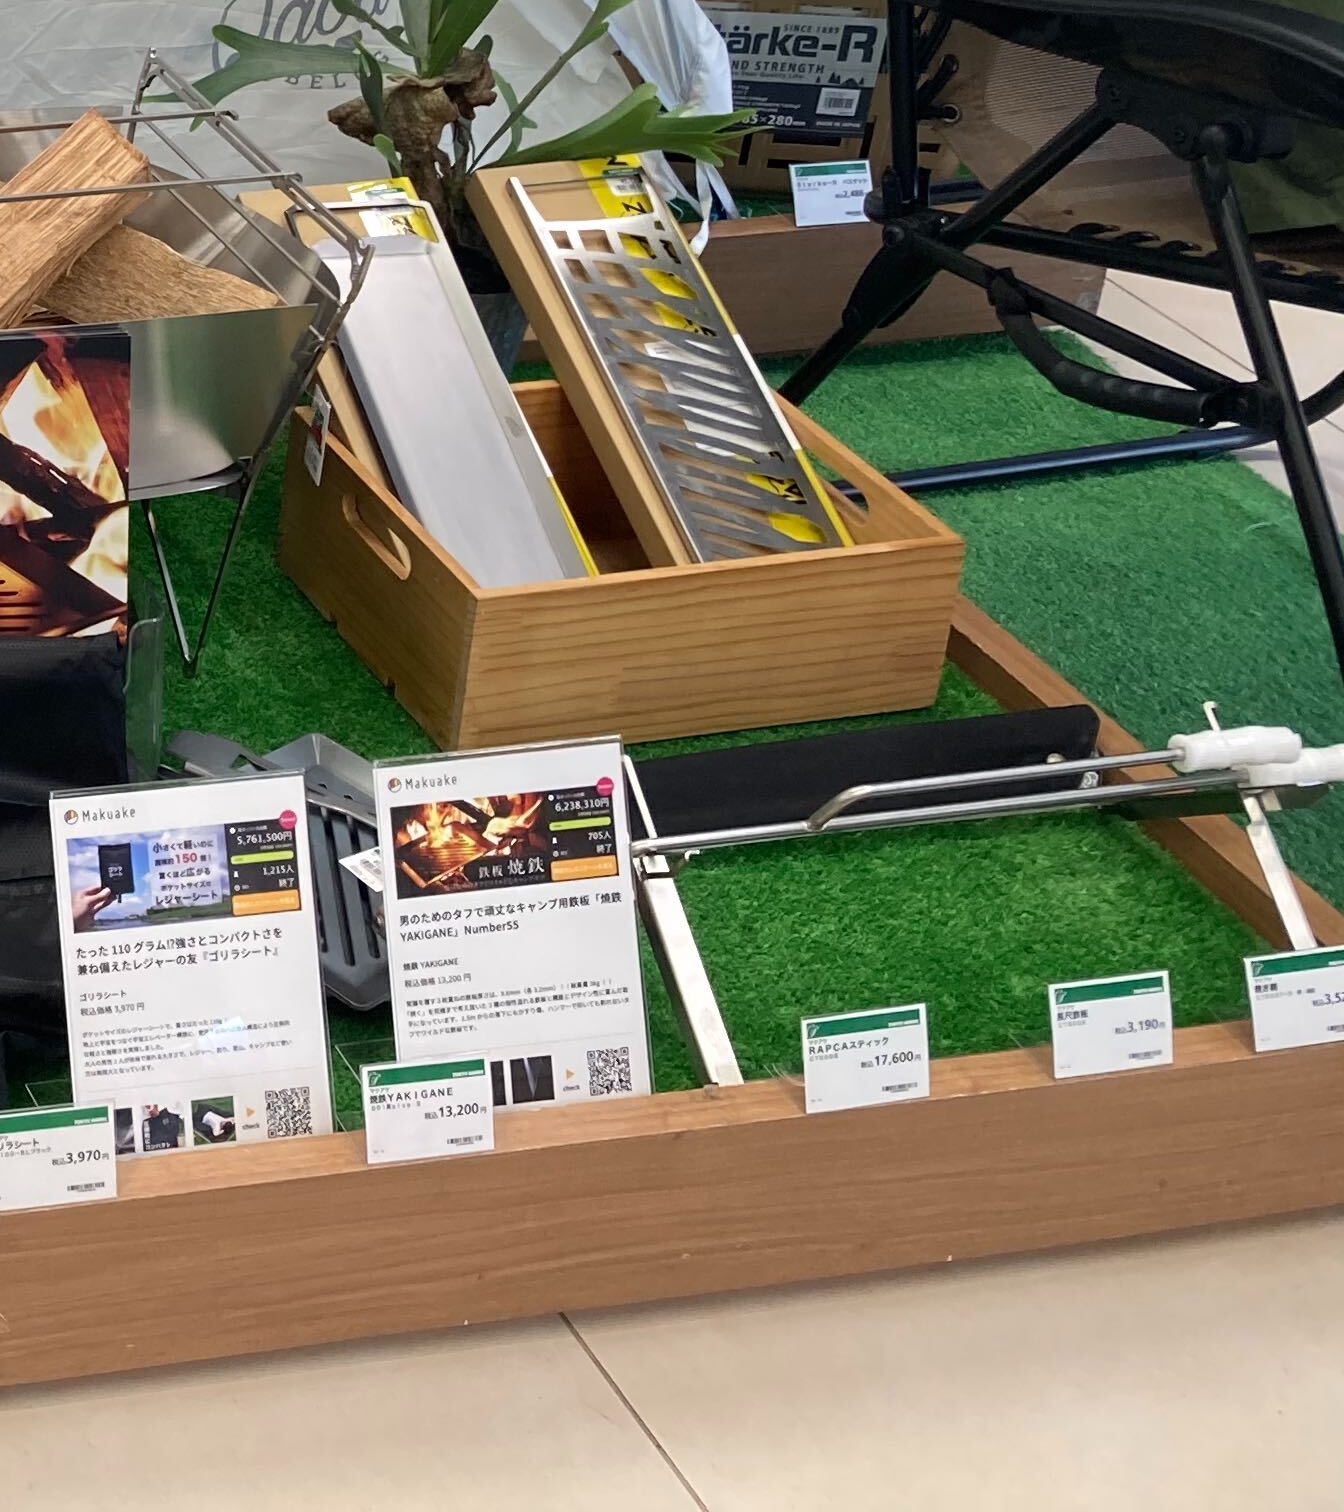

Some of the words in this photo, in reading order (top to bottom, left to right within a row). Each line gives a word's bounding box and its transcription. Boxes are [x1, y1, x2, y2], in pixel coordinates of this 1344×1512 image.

[784, 23, 812, 33] SINCE
[712, 24, 878, 63] ärke-R
[754, 60, 825, 74] STRENGTH
[404, 776, 458, 790] Makuake
[82, 807, 136, 822] Makuake
[76, 946, 109, 960] たった
[112, 943, 132, 956] 110
[79, 989, 127, 1003] ゴリラシート
[52, 1149, 110, 1166] 税込3,970円
